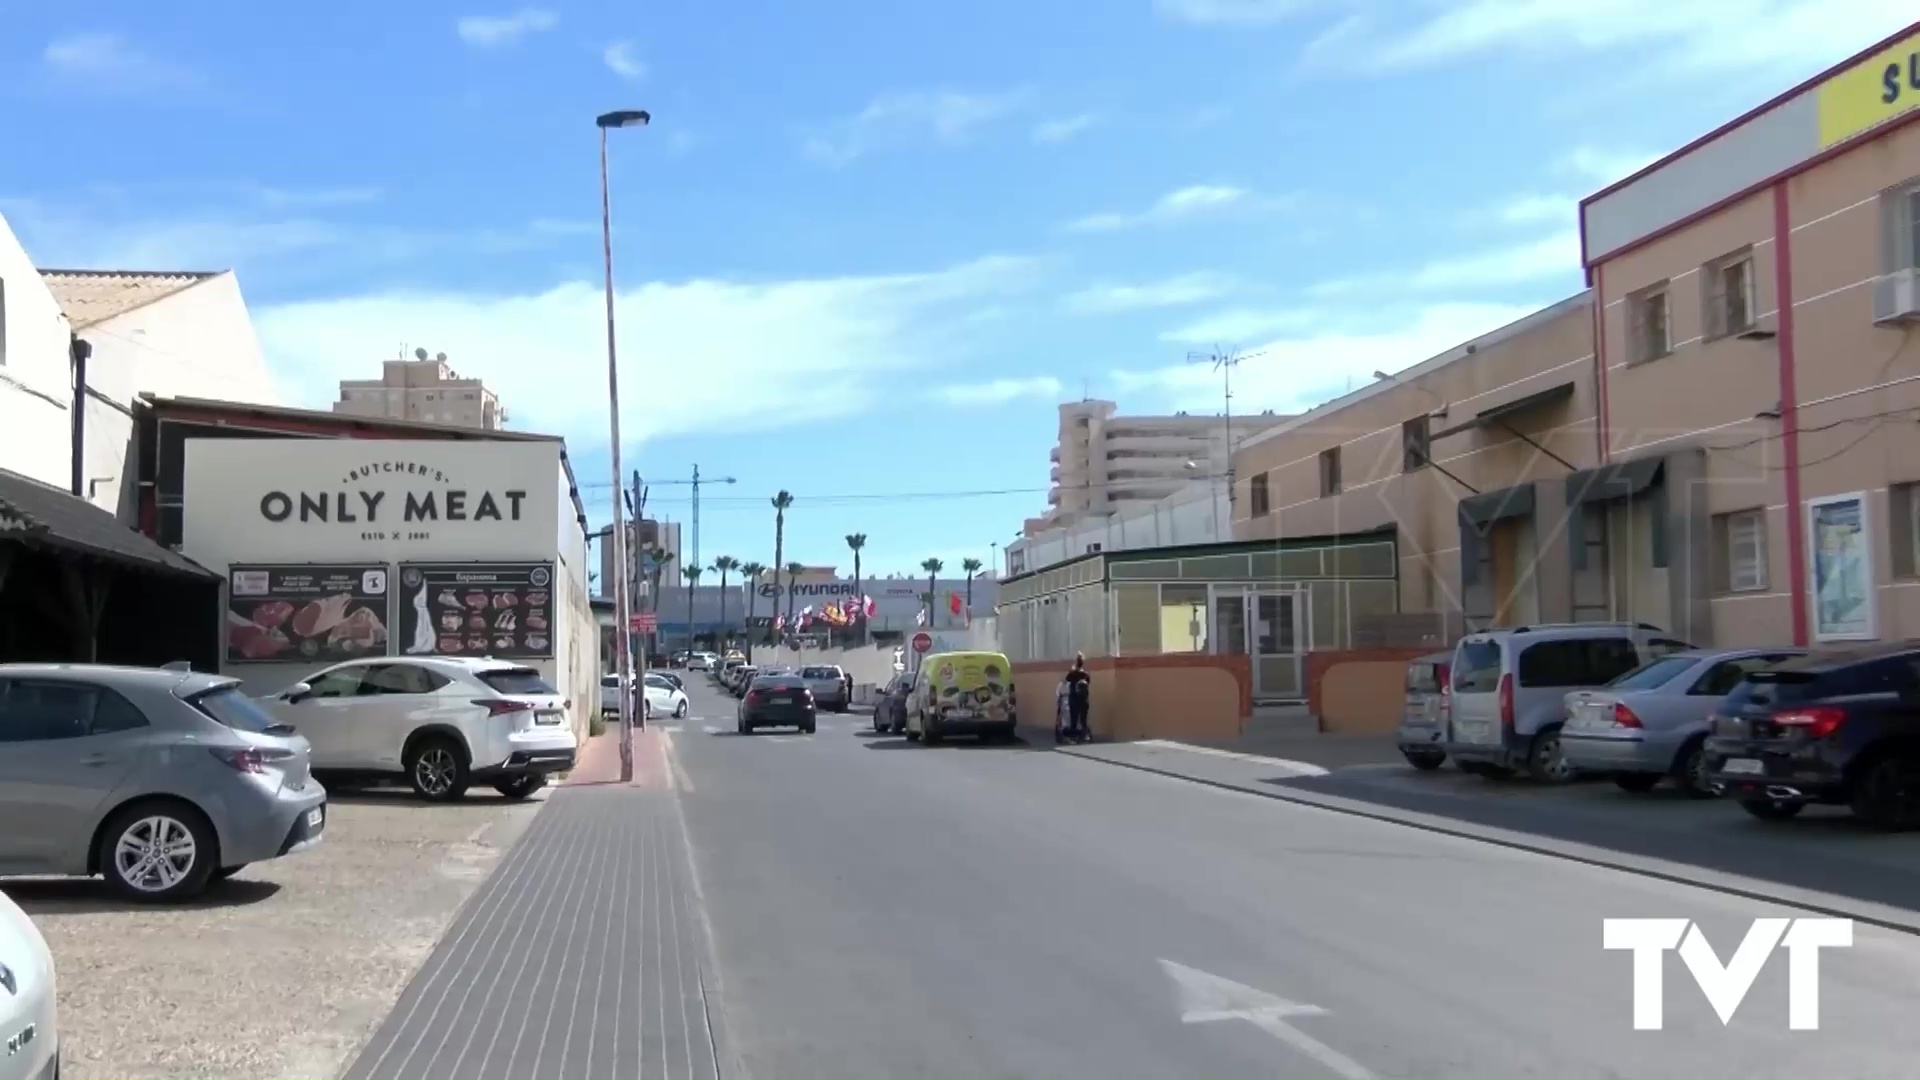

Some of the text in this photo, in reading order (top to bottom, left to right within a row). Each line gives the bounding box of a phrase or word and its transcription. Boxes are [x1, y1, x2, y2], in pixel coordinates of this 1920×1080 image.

[349, 461, 442, 481] BUTCHER'S
[260, 490, 526, 522] ONLY MEAT
[789, 583, 855, 596] HYUNDAI
